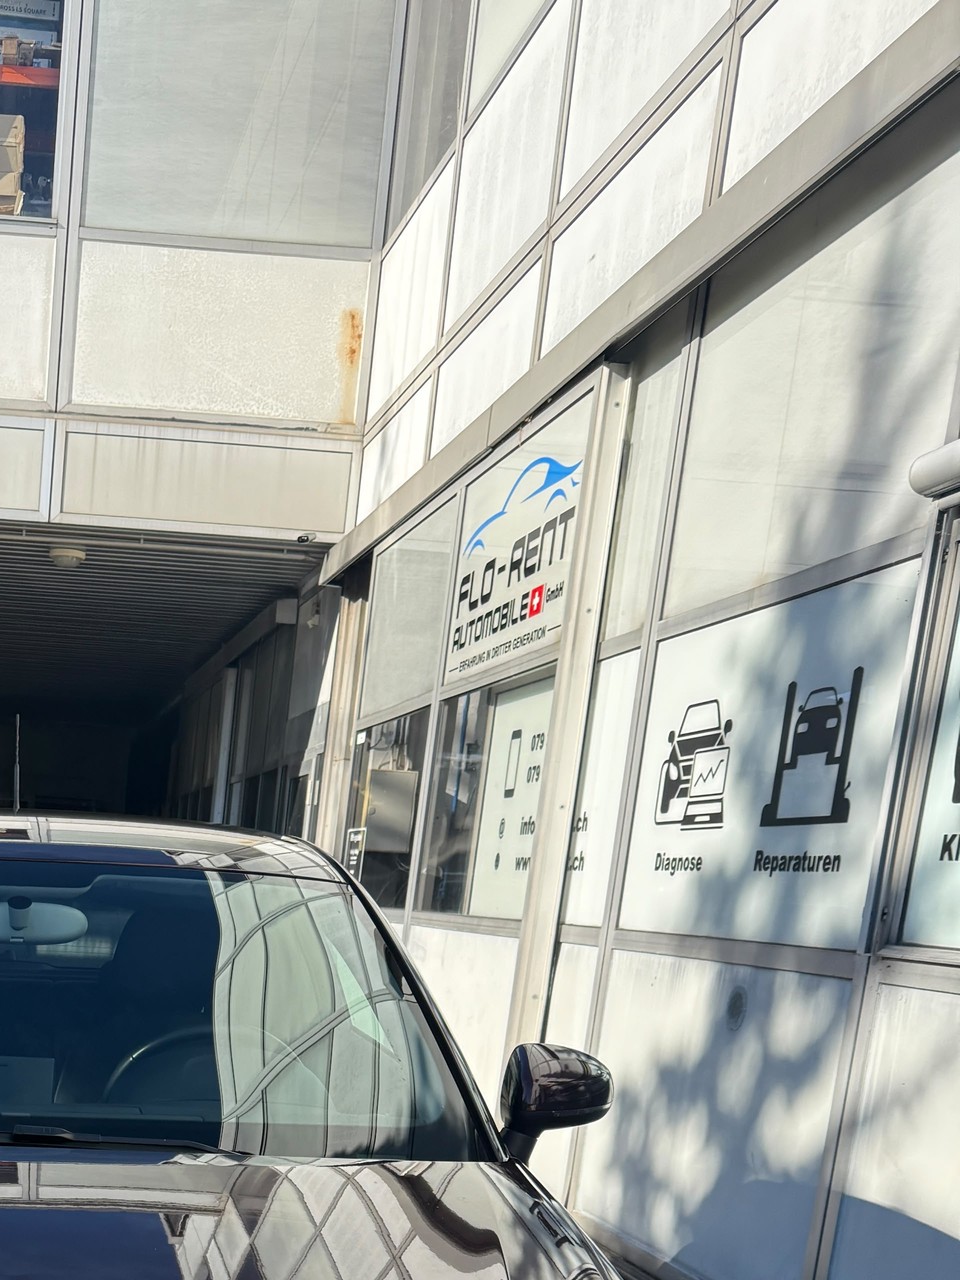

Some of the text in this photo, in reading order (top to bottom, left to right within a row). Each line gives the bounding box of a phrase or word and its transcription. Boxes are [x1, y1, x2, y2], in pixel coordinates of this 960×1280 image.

[456, 505, 576, 619] FLO-RENT
[451, 581, 565, 653] AUTOMOBILE GmbH
[458, 625, 547, 672] ERFAHRUNG IN DRITTER GENERATION
[531, 733, 545, 751] 079
[526, 765, 540, 783] 079
[654, 852, 703, 876] Diagnose
[753, 850, 841, 877] Reparaturen
